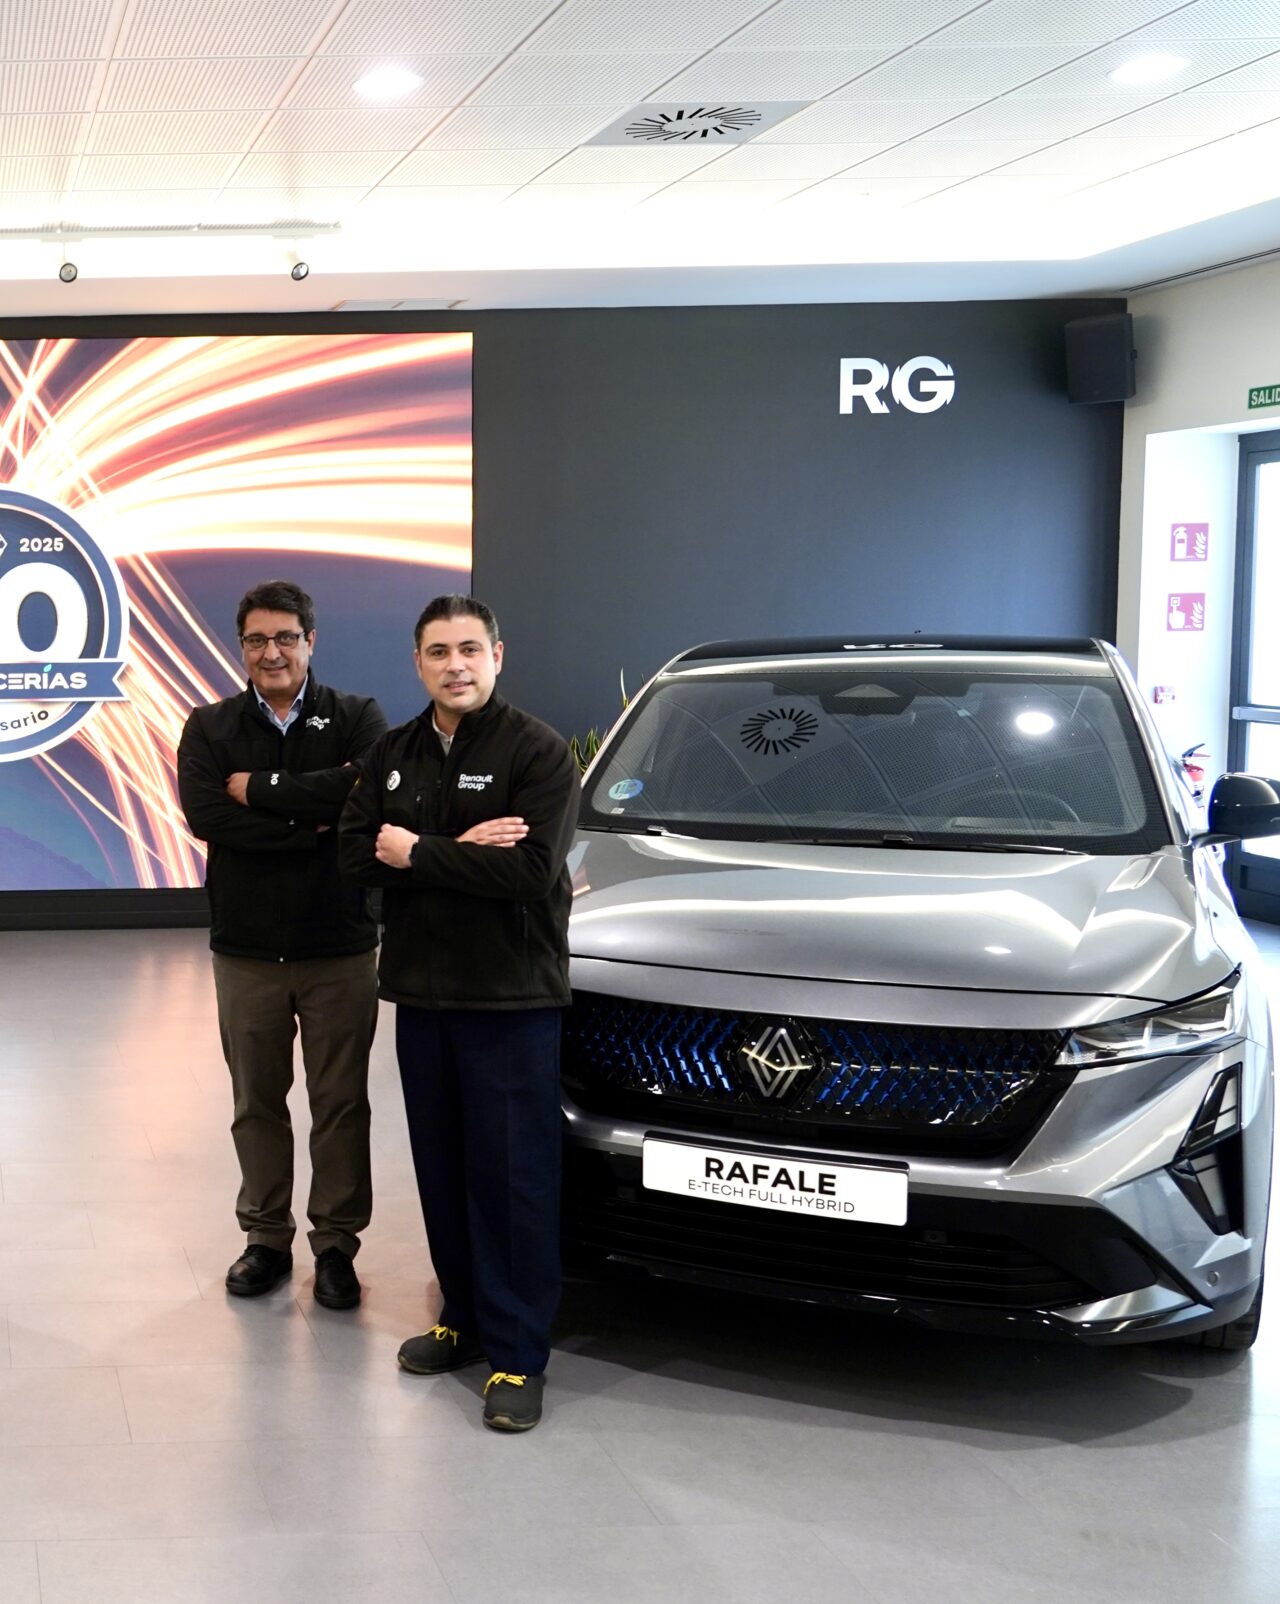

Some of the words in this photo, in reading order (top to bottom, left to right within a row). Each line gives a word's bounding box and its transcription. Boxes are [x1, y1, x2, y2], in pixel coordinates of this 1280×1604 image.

[839, 355, 956, 415] RG
[20, 538, 64, 552] 2025
[457, 780, 485, 791] Group
[459, 774, 493, 783] Renault
[704, 1156, 837, 1197] RAFALE
[688, 1179, 744, 1198] E-TECH
[748, 1188, 787, 1205] FULL
[791, 1196, 855, 1213] HYBRID
